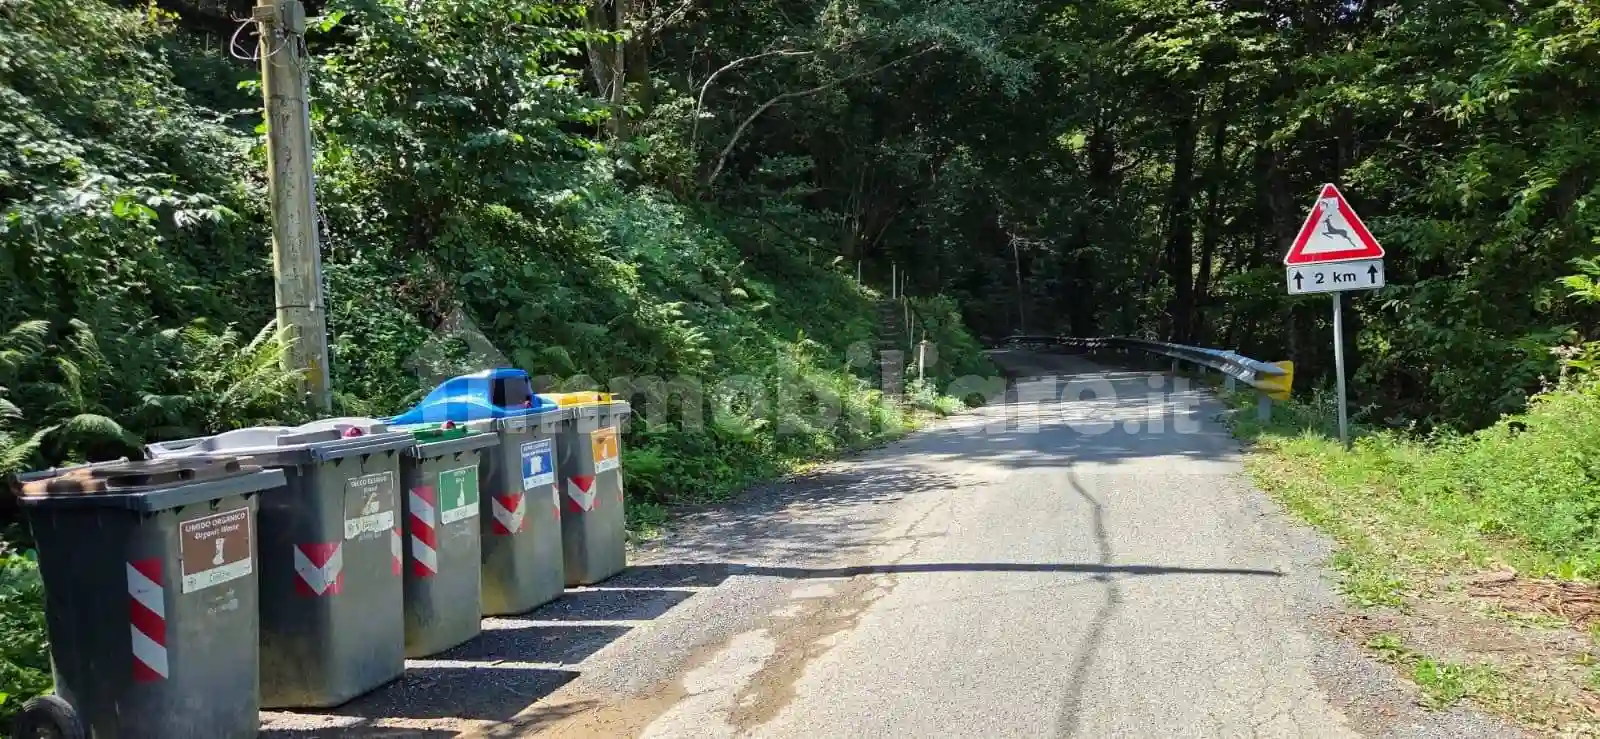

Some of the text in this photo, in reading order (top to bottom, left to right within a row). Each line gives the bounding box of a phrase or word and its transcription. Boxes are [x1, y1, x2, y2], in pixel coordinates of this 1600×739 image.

[1314, 271, 1357, 284] 2 km
[212, 512, 246, 526] ORGANICO
